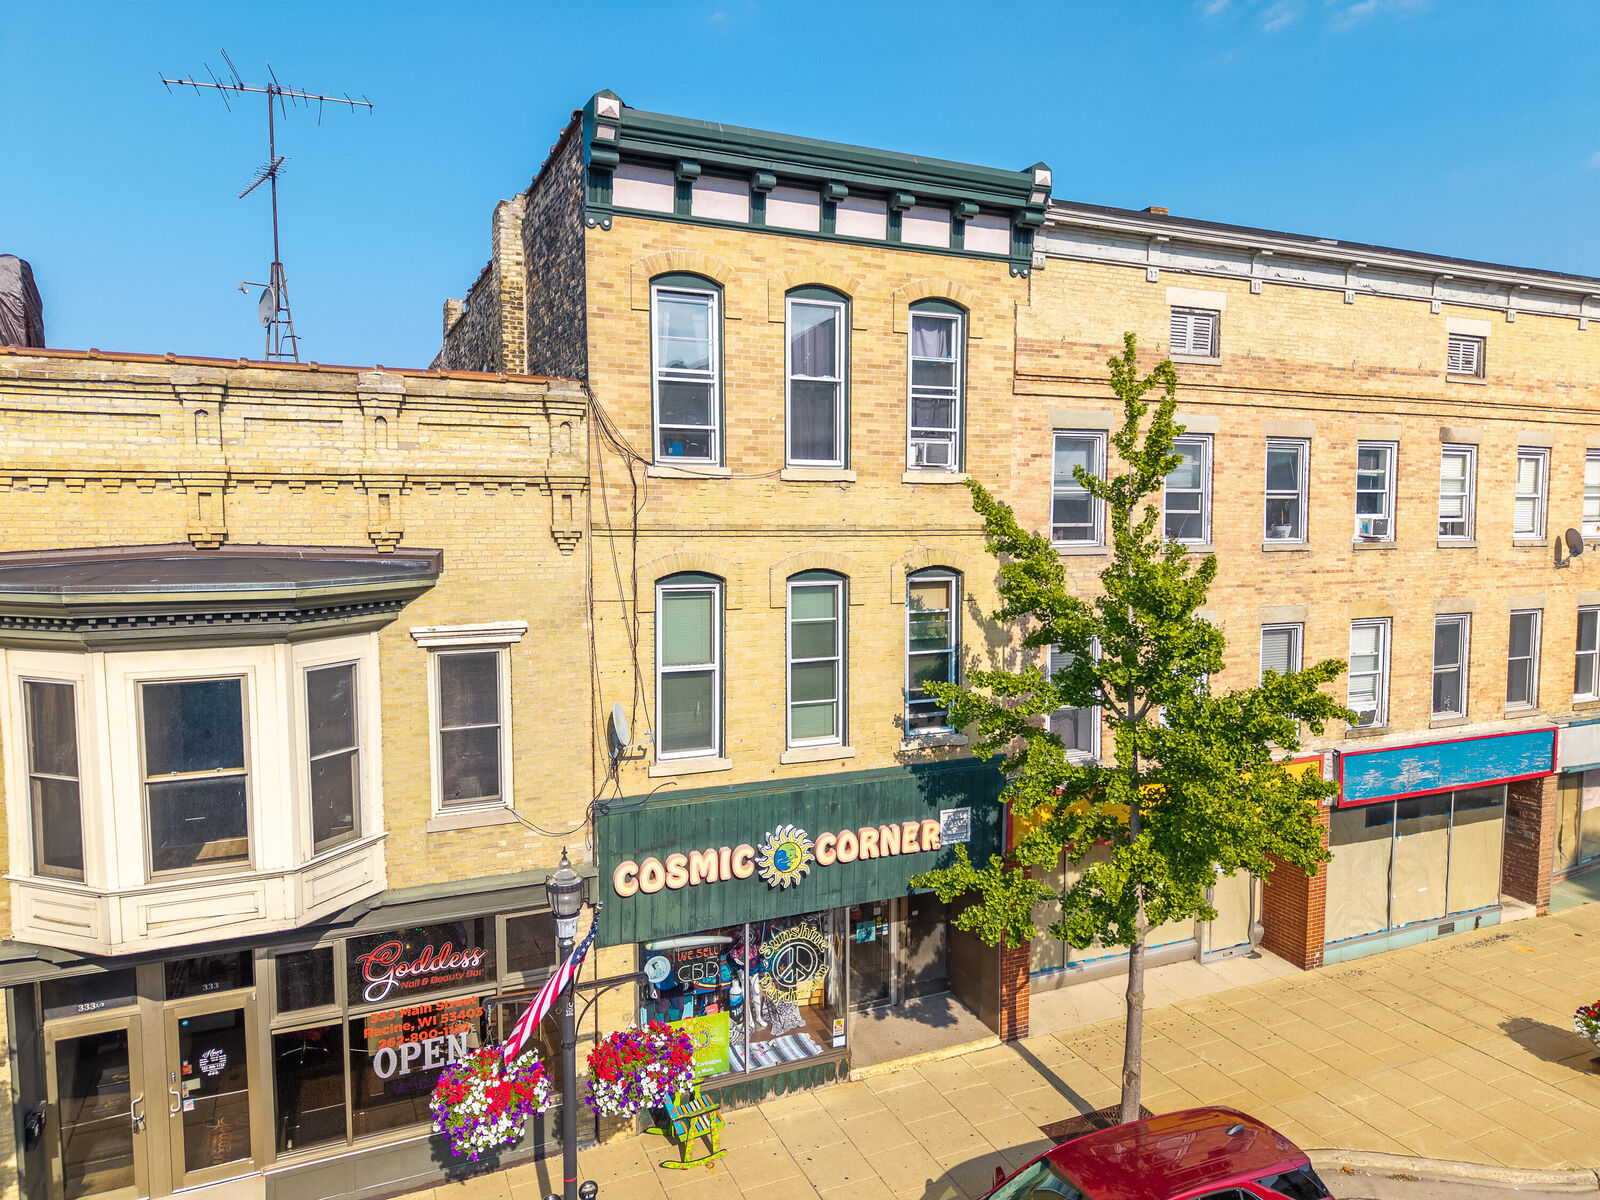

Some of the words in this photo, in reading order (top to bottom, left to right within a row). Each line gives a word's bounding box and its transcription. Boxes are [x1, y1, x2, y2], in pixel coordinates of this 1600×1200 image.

[613, 844, 755, 897] COSMIC
[814, 819, 942, 866] CORNER
[677, 950, 693, 962] WE
[696, 945, 719, 959] SELL
[759, 922, 829, 959] Sunshine
[356, 940, 488, 1002] Goddess
[401, 980, 420, 989] Nail
[430, 972, 464, 984] Beauty
[466, 969, 484, 978] Bar
[677, 961, 720, 983] CBD
[203, 982, 219, 992] 333
[363, 1021, 415, 1039] Racine,
[417, 1015, 437, 1028] WI
[440, 1006, 484, 1024] 53403
[370, 1010, 396, 1024] 333
[400, 1004, 433, 1018] Main
[436, 995, 478, 1011] Street
[373, 1031, 469, 1079] OPEN
